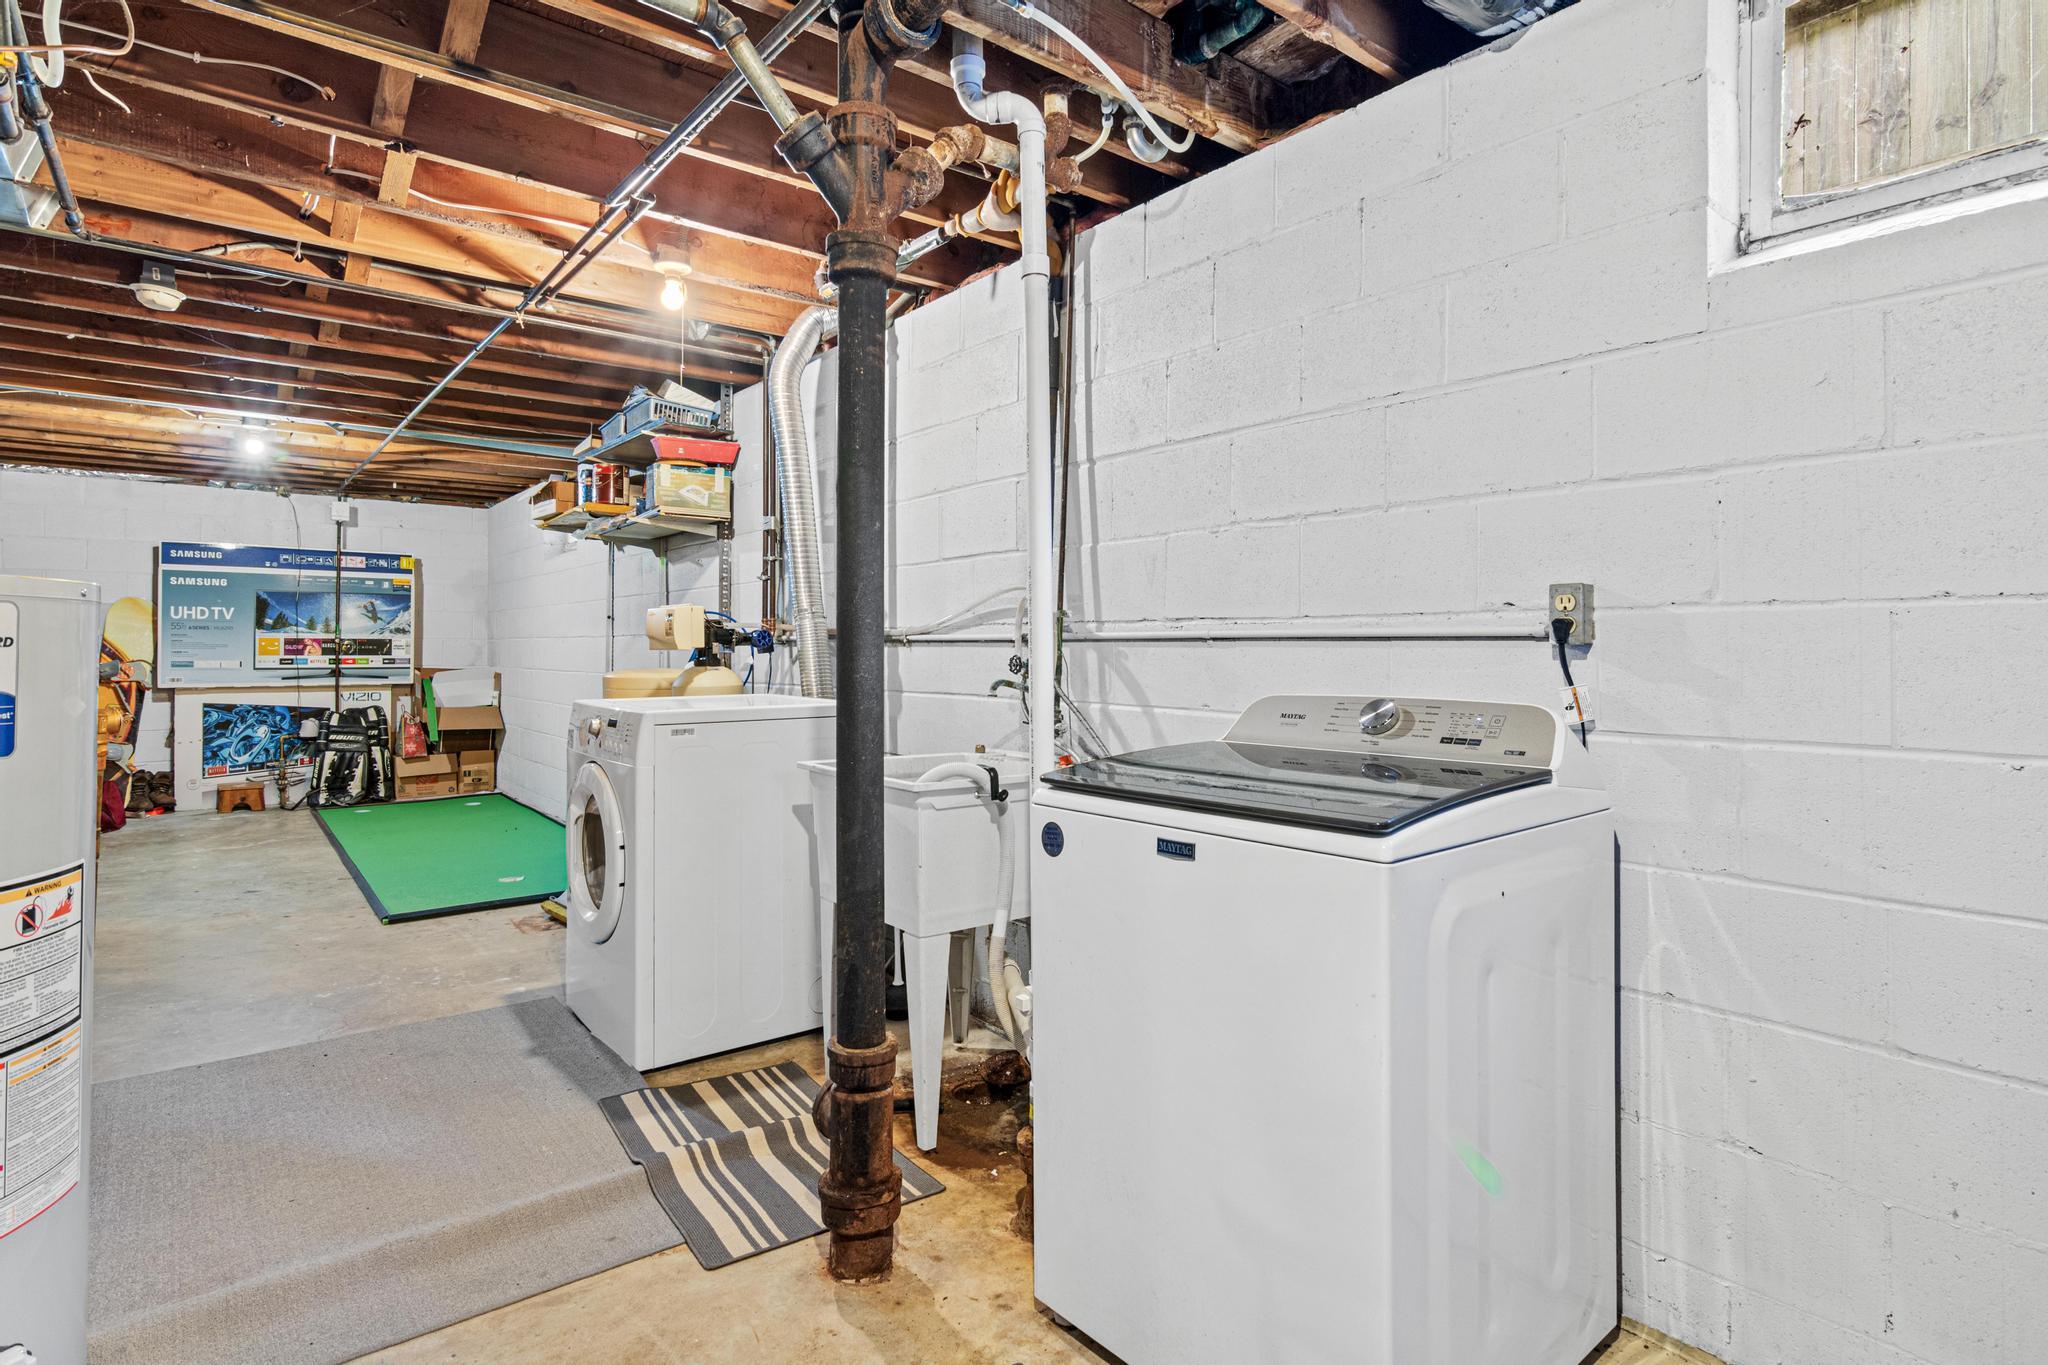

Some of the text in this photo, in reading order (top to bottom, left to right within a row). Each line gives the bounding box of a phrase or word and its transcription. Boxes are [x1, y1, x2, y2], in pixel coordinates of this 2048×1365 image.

[170, 549, 223, 559] SAMSUNG
[170, 576, 228, 587] SAMSUNG
[170, 605, 235, 620] UHD TV
[340, 692, 382, 701] VIZIO
[1158, 841, 1192, 856] MAYTAG
[34, 881, 62, 894] WARNING
